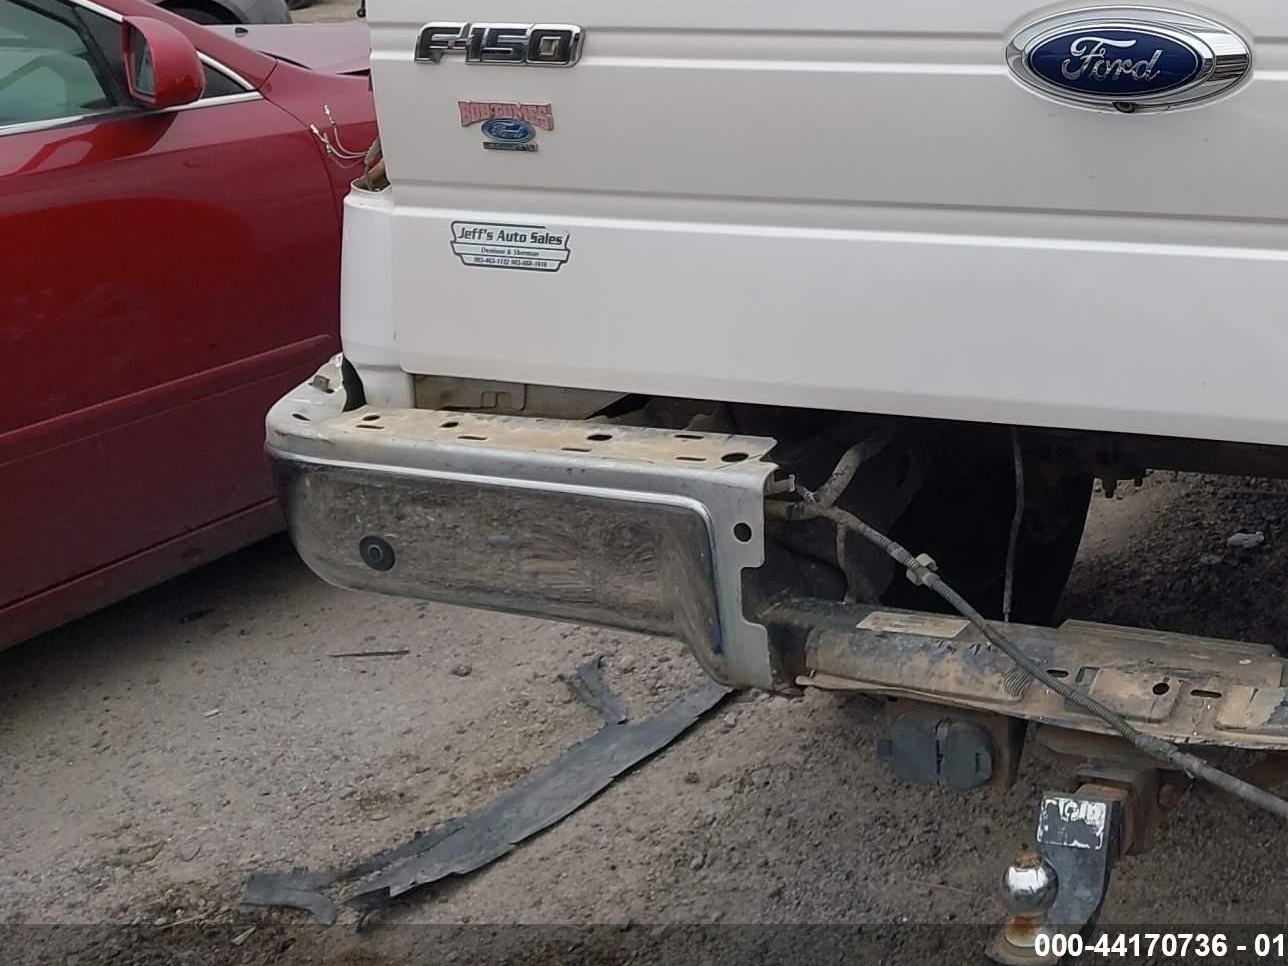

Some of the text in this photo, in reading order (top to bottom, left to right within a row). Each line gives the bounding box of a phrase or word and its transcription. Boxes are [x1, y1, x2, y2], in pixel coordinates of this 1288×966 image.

[1059, 36, 1163, 82] Ford
[458, 227, 563, 246] Jeff's Auto Sales
